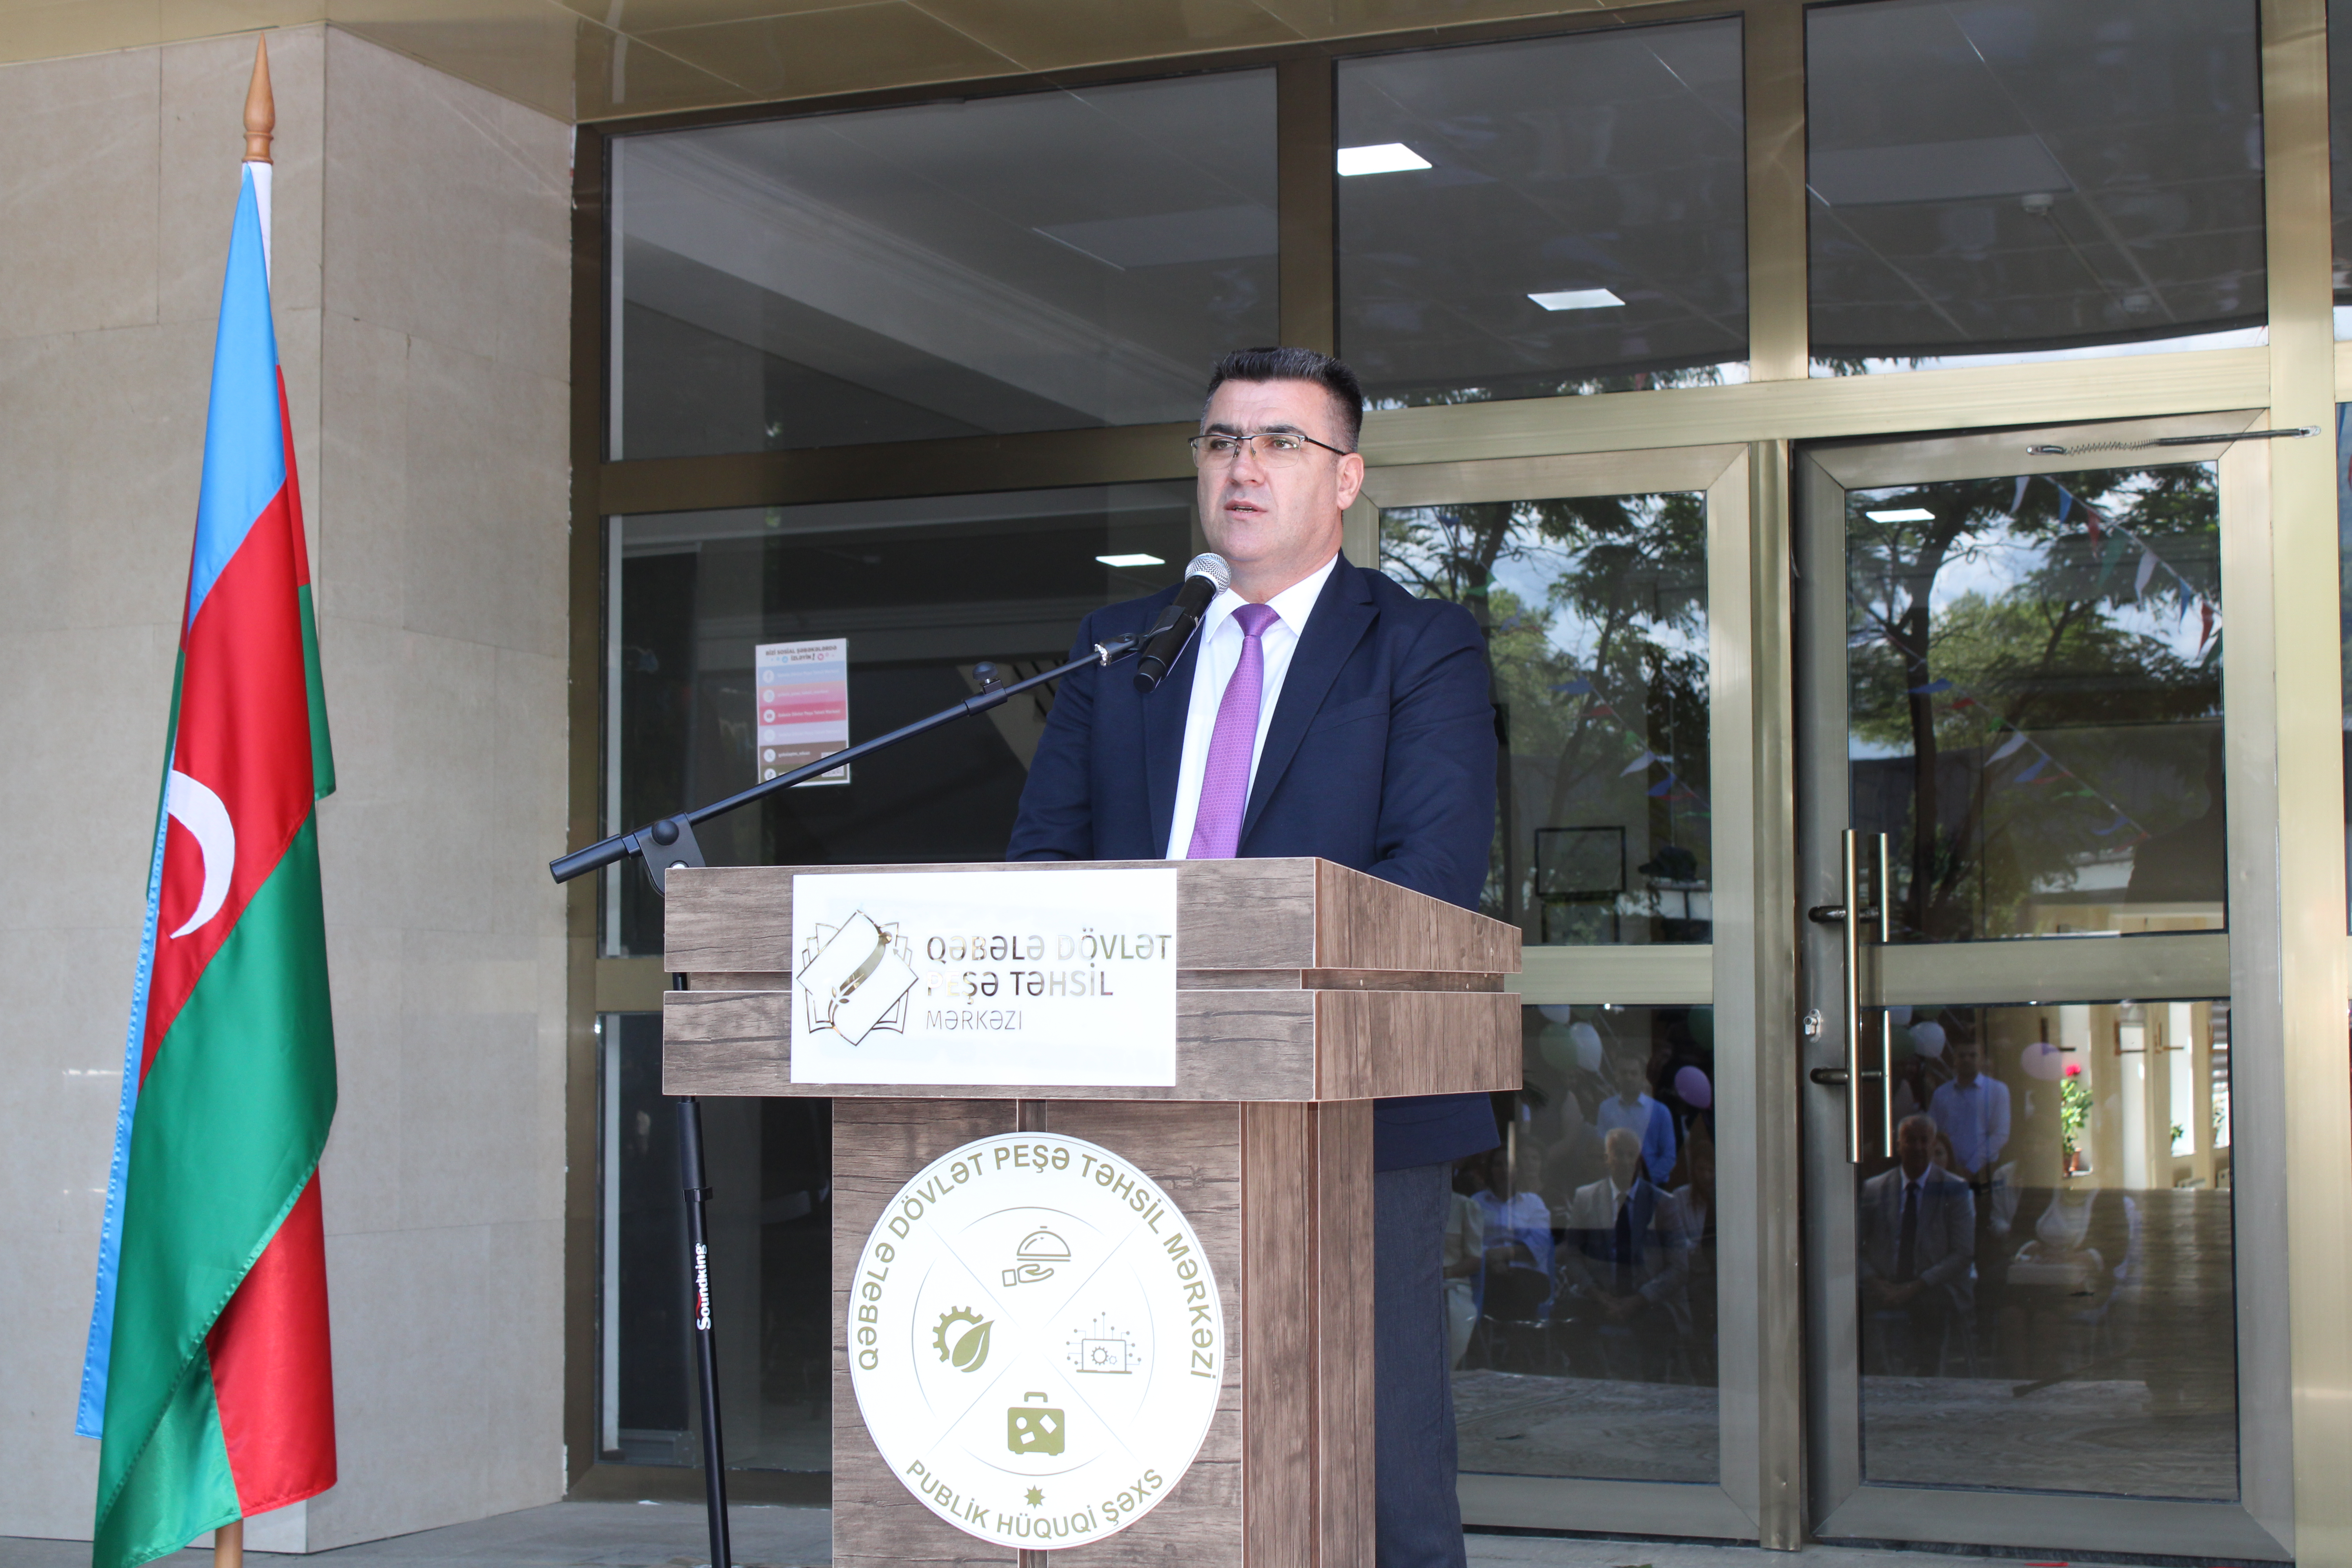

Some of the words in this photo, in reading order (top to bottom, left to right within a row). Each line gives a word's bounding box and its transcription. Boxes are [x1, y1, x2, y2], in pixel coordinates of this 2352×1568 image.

[927, 935, 1045, 964] QƏBƏLƏ
[1057, 928, 1172, 960] DÖVLƏT
[927, 971, 998, 1004] PEŞƏ
[1010, 963, 1113, 996] TƏHSİL
[695, 1243, 711, 1330] Soundking
[858, 1242, 895, 1370] QƏBƏLƏ
[889, 1152, 983, 1239] DÖVLƏT
[995, 1144, 1070, 1173] PEŞƏ
[1081, 1154, 1168, 1234] TƏHSİL
[1163, 1233, 1217, 1379] MƏRKƏZİ
[906, 1459, 990, 1528] PUBLİK
[997, 1504, 1097, 1539] HÜQUQİ
[1102, 1468, 1163, 1526] ŞƏXS
